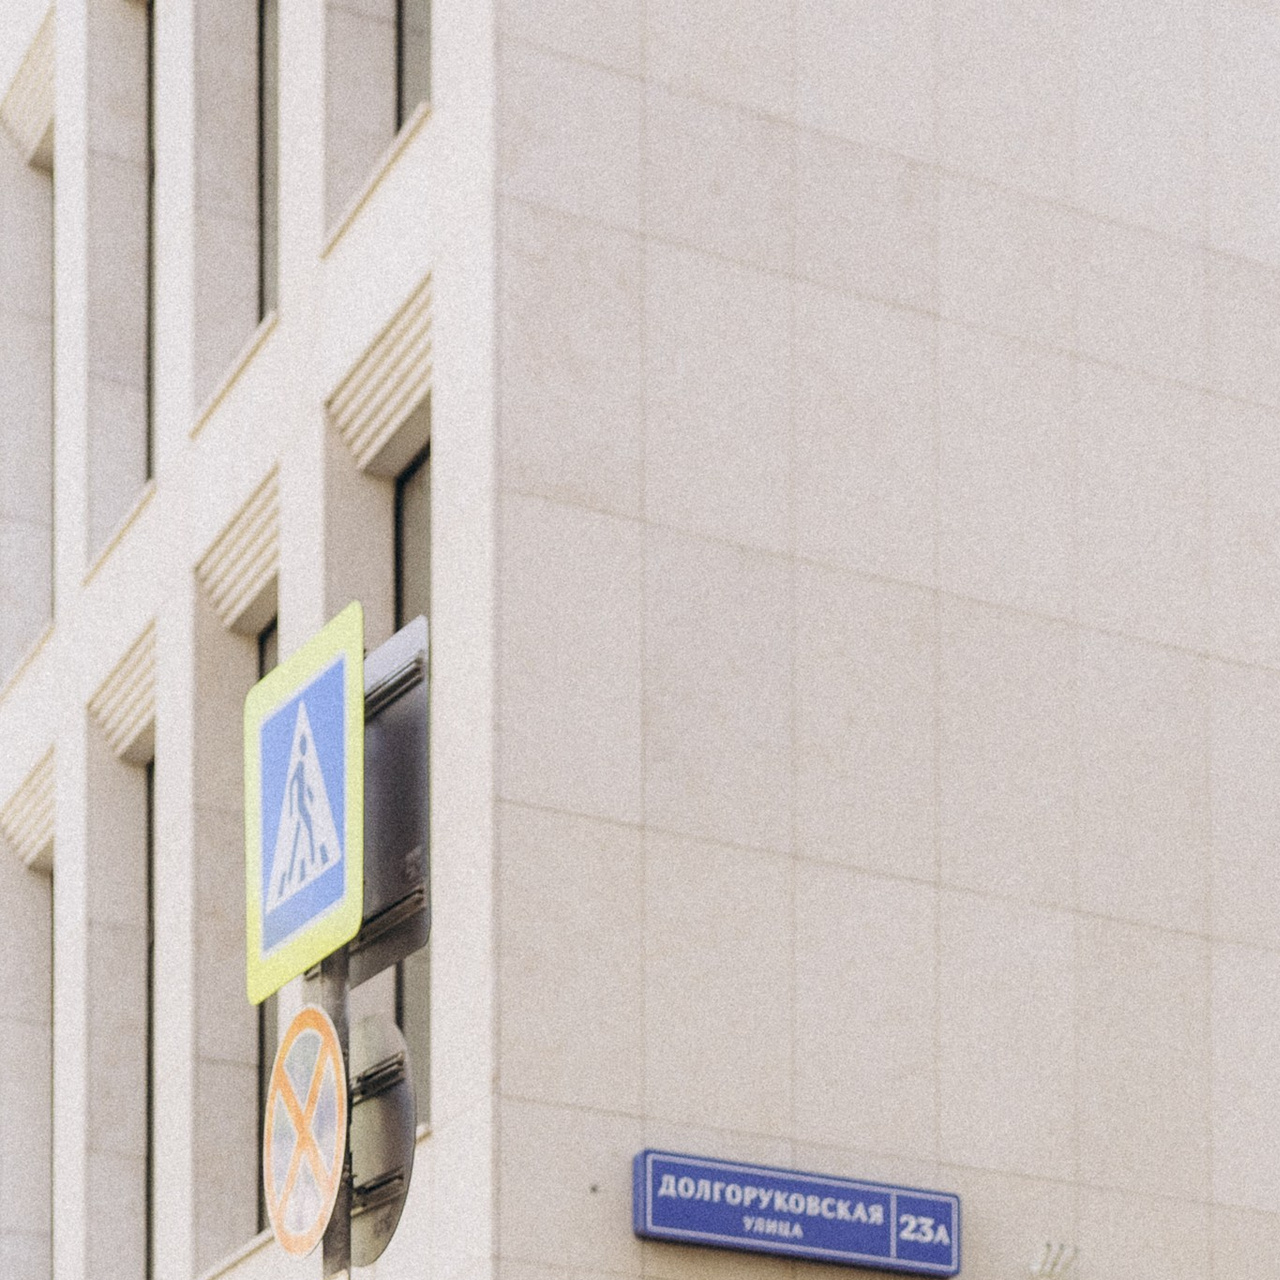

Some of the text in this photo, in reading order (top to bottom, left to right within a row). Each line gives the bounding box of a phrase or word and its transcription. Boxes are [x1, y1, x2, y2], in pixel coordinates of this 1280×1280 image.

[657, 1174, 884, 1225] ДОЛГОРУКОВСКАЯ
[743, 1216, 804, 1239] УЛИЦА
[900, 1214, 950, 1245] 23А
